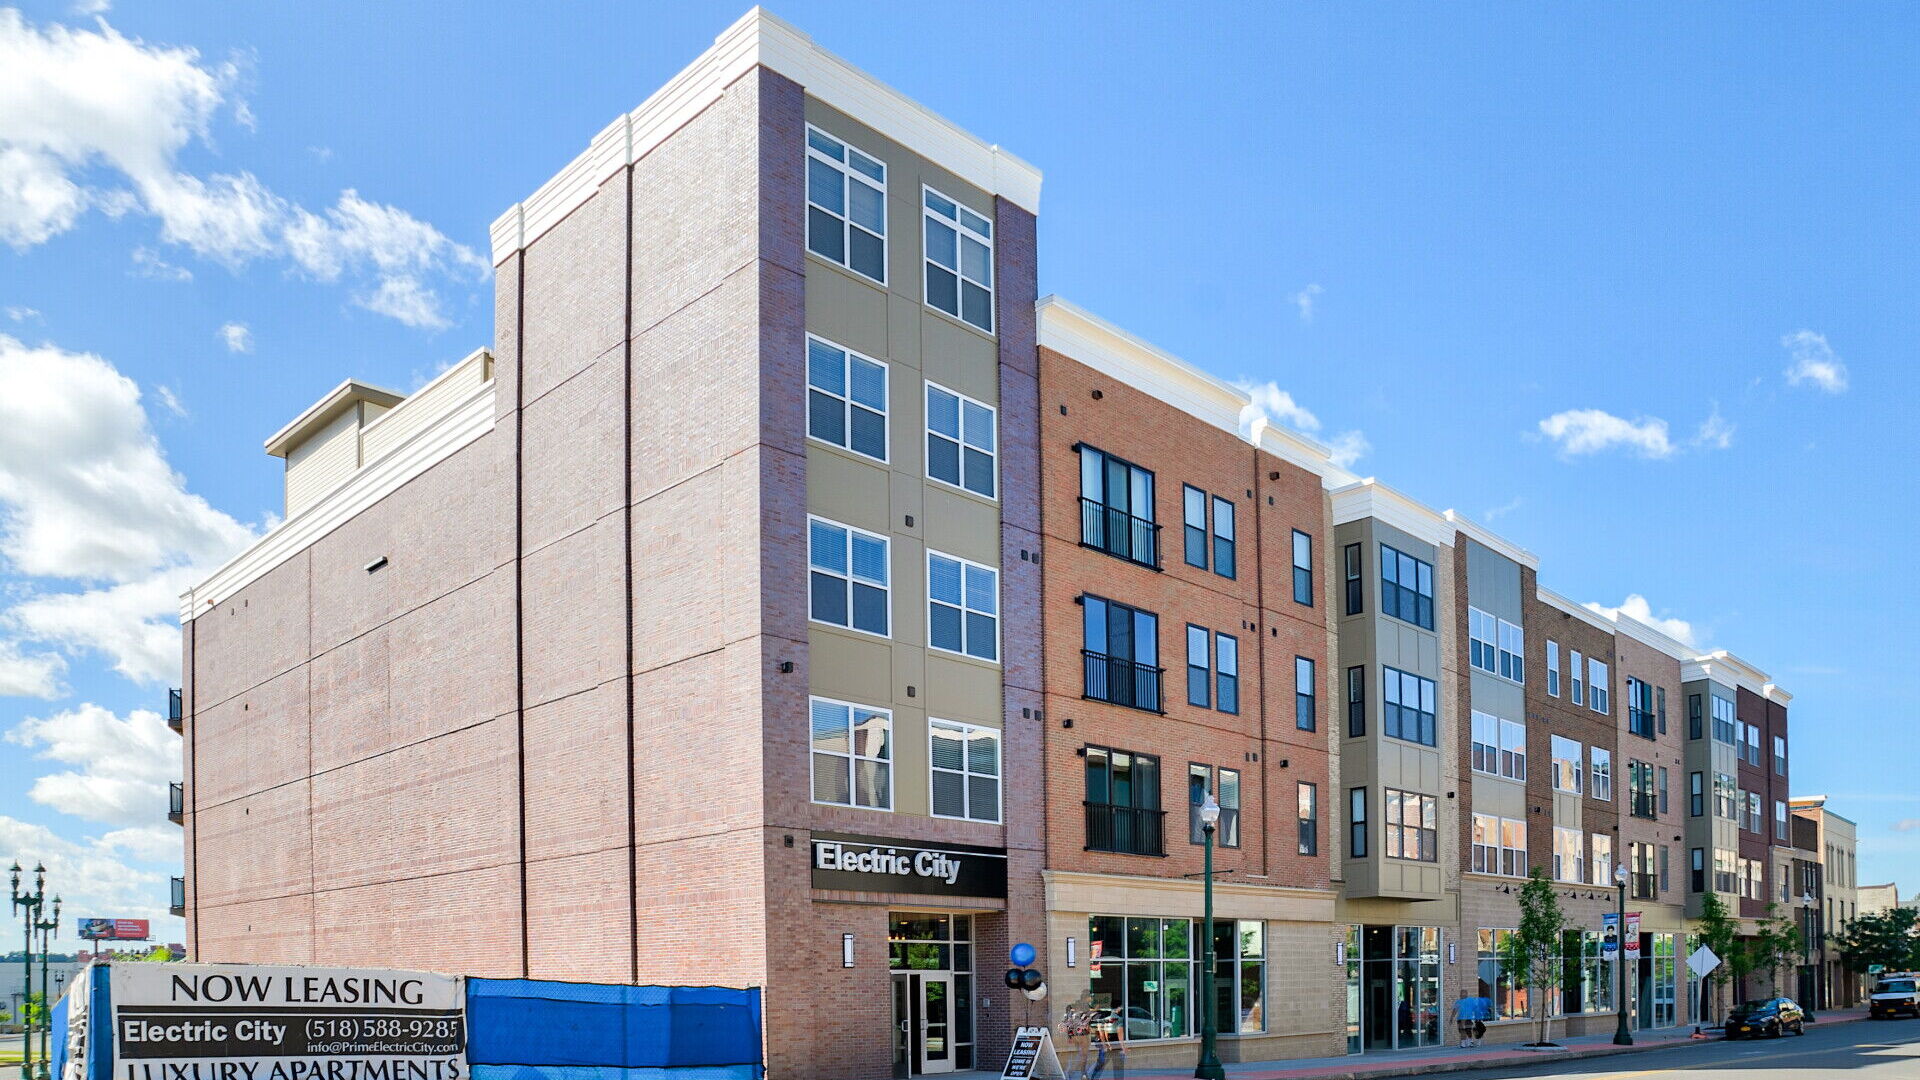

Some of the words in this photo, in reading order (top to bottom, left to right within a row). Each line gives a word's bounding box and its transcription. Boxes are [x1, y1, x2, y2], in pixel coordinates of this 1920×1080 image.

[816, 843, 910, 875] Electric
[915, 851, 961, 884] City
[172, 975, 272, 1002] NOW
[285, 977, 423, 1004] LEASING
[124, 1020, 228, 1042] Electric
[235, 1020, 286, 1046] City
[305, 1018, 359, 1040] (518)
[363, 1019, 458, 1038] 588-9285
[128, 1061, 259, 1080] LUXURY
[270, 1058, 460, 1080] APARTMENTS
